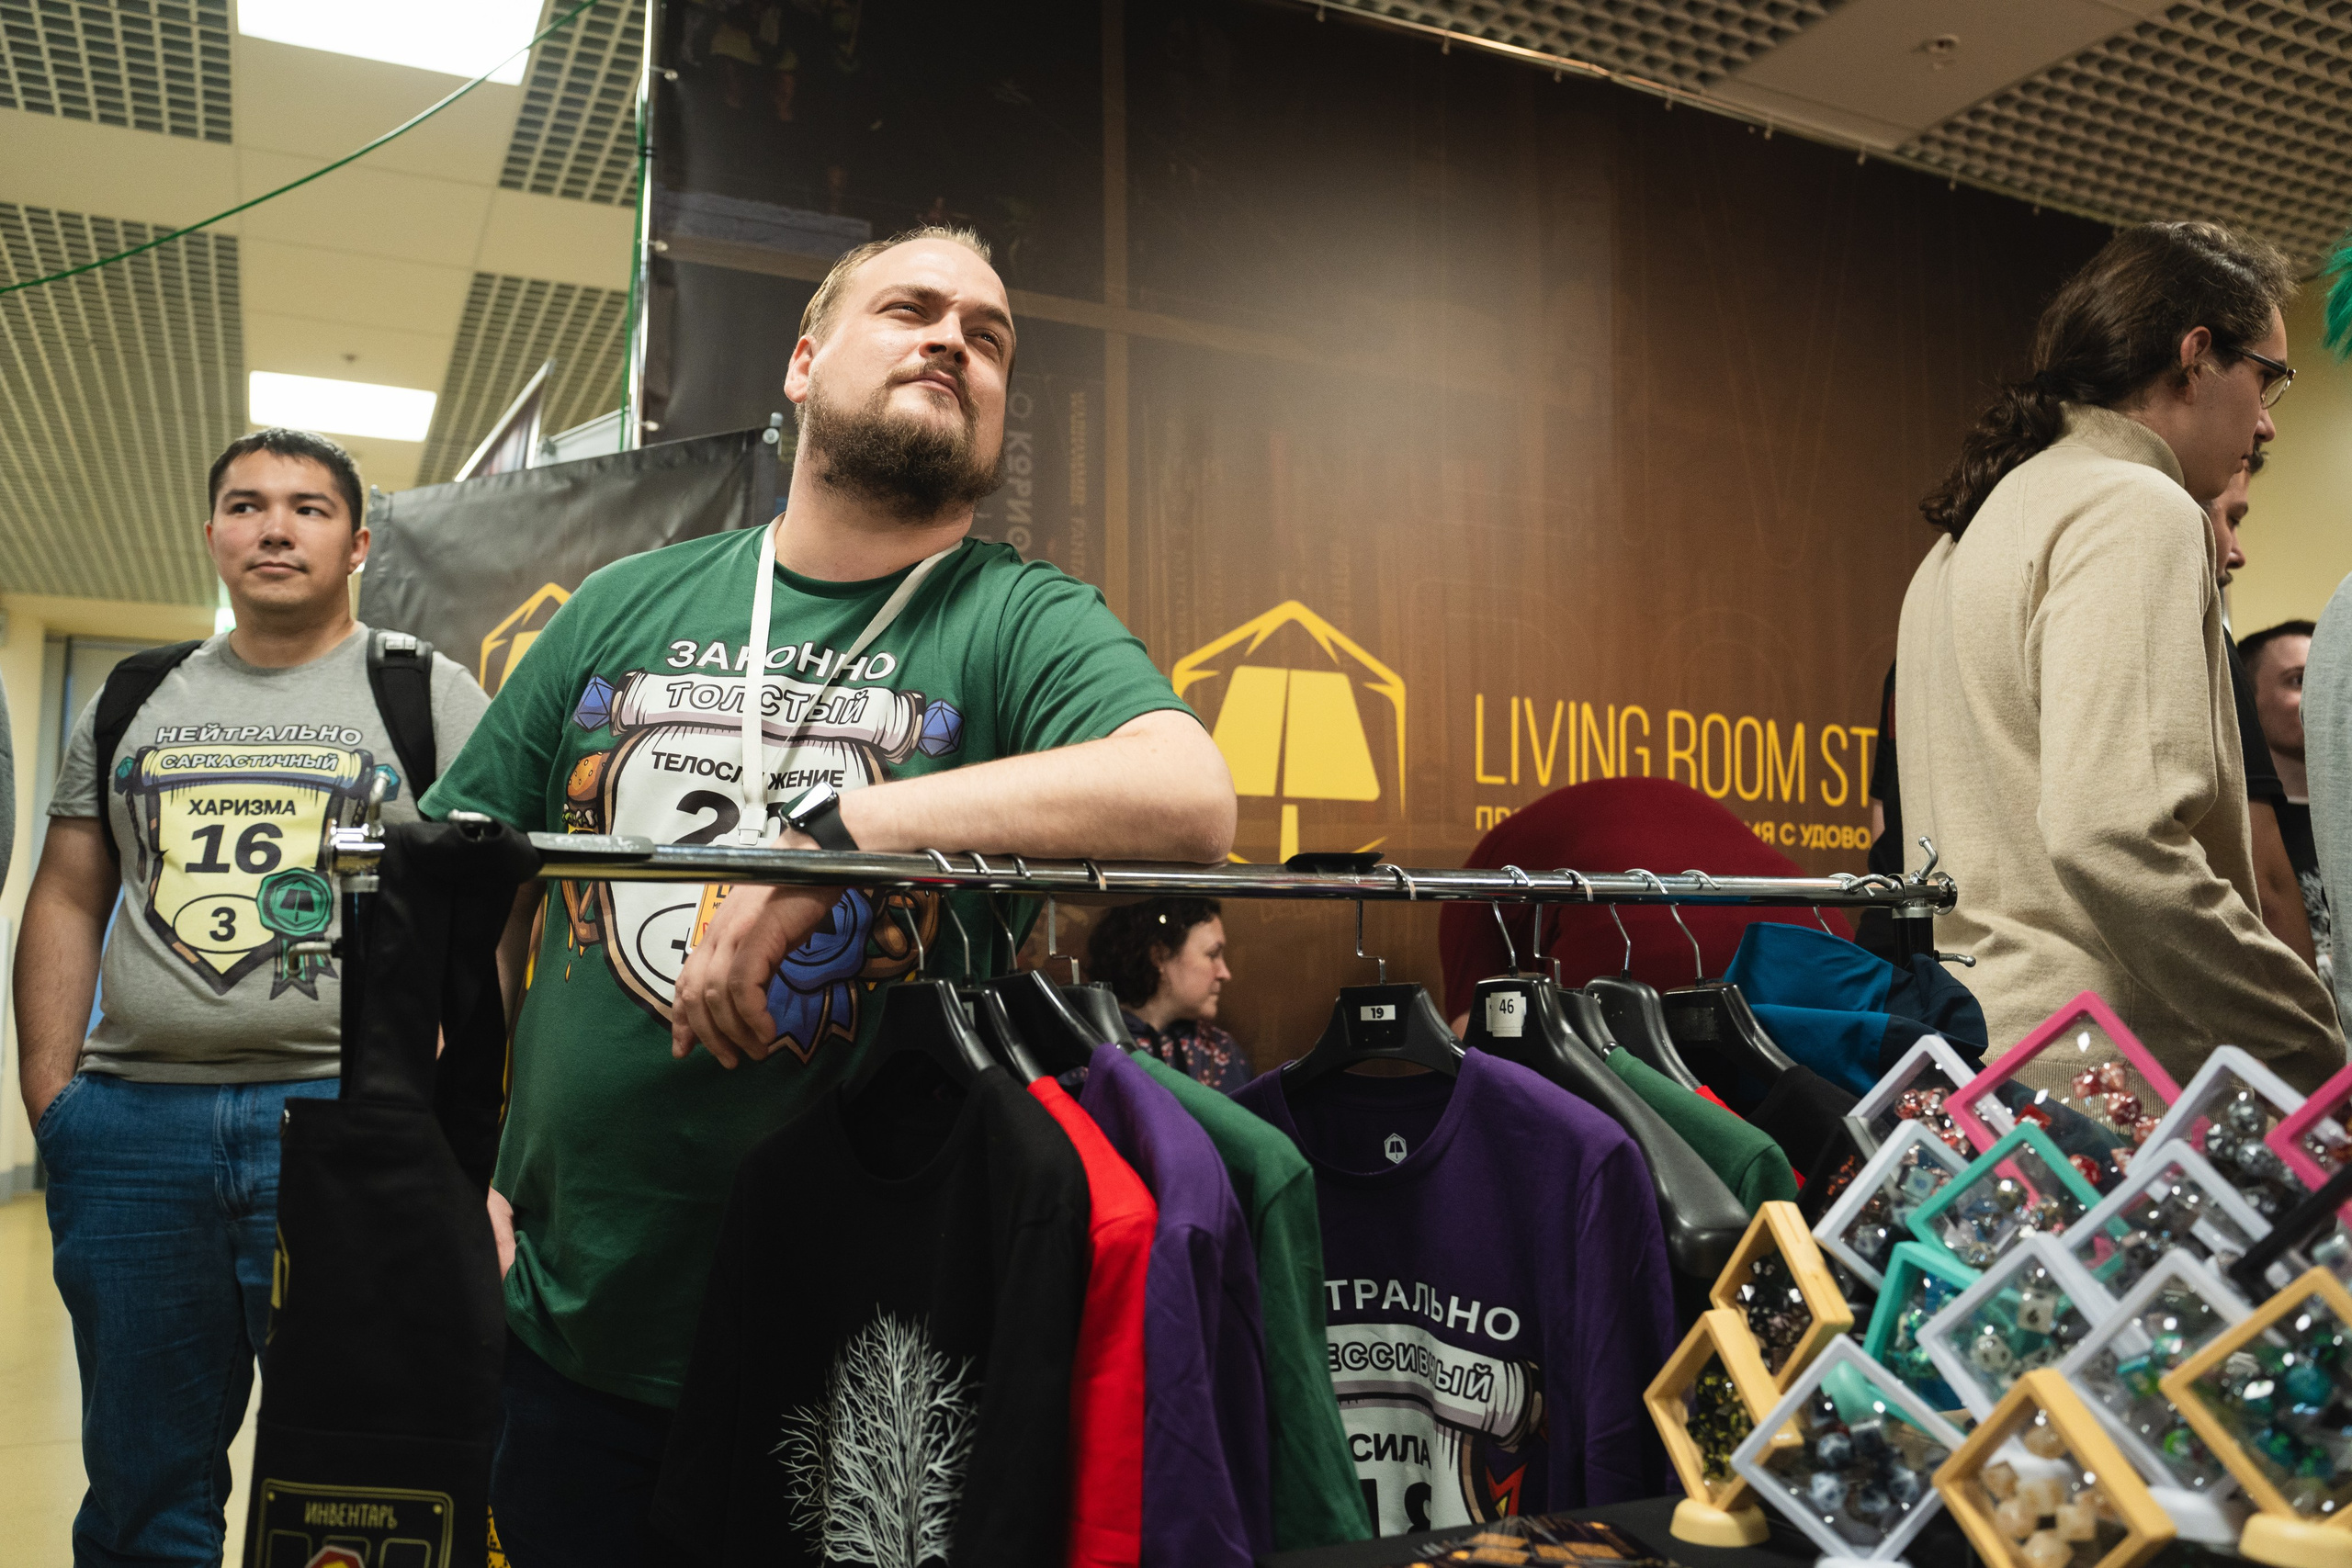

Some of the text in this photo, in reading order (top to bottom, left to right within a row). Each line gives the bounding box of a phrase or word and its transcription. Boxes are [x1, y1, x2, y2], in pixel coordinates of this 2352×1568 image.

[1007, 431, 1033, 558] КОРИО
[155, 723, 363, 746] НЕЙТРАЛЬНО
[1476, 693, 1879, 807] LIVING ROOM ST
[161, 753, 340, 771] САРКАСТИЧНЫЙ
[651, 750, 845, 790] ТЕЛОСЖЕНИЕ
[187, 799, 297, 816] ХАРИЗМА
[1476, 805, 1521, 830] ПР
[1779, 822, 1796, 846] С
[1799, 824, 1872, 851] УДОВО
[185, 822, 284, 874] 16
[209, 907, 237, 942] 3
[1370, 1007, 1385, 1019] 19
[1498, 998, 1515, 1015] 46
[1325, 1279, 1521, 1341] ТРАЛЬНО
[1347, 1433, 1432, 1470] СИЛА
[303, 1500, 399, 1530] ИНВЕНТАРЬ
